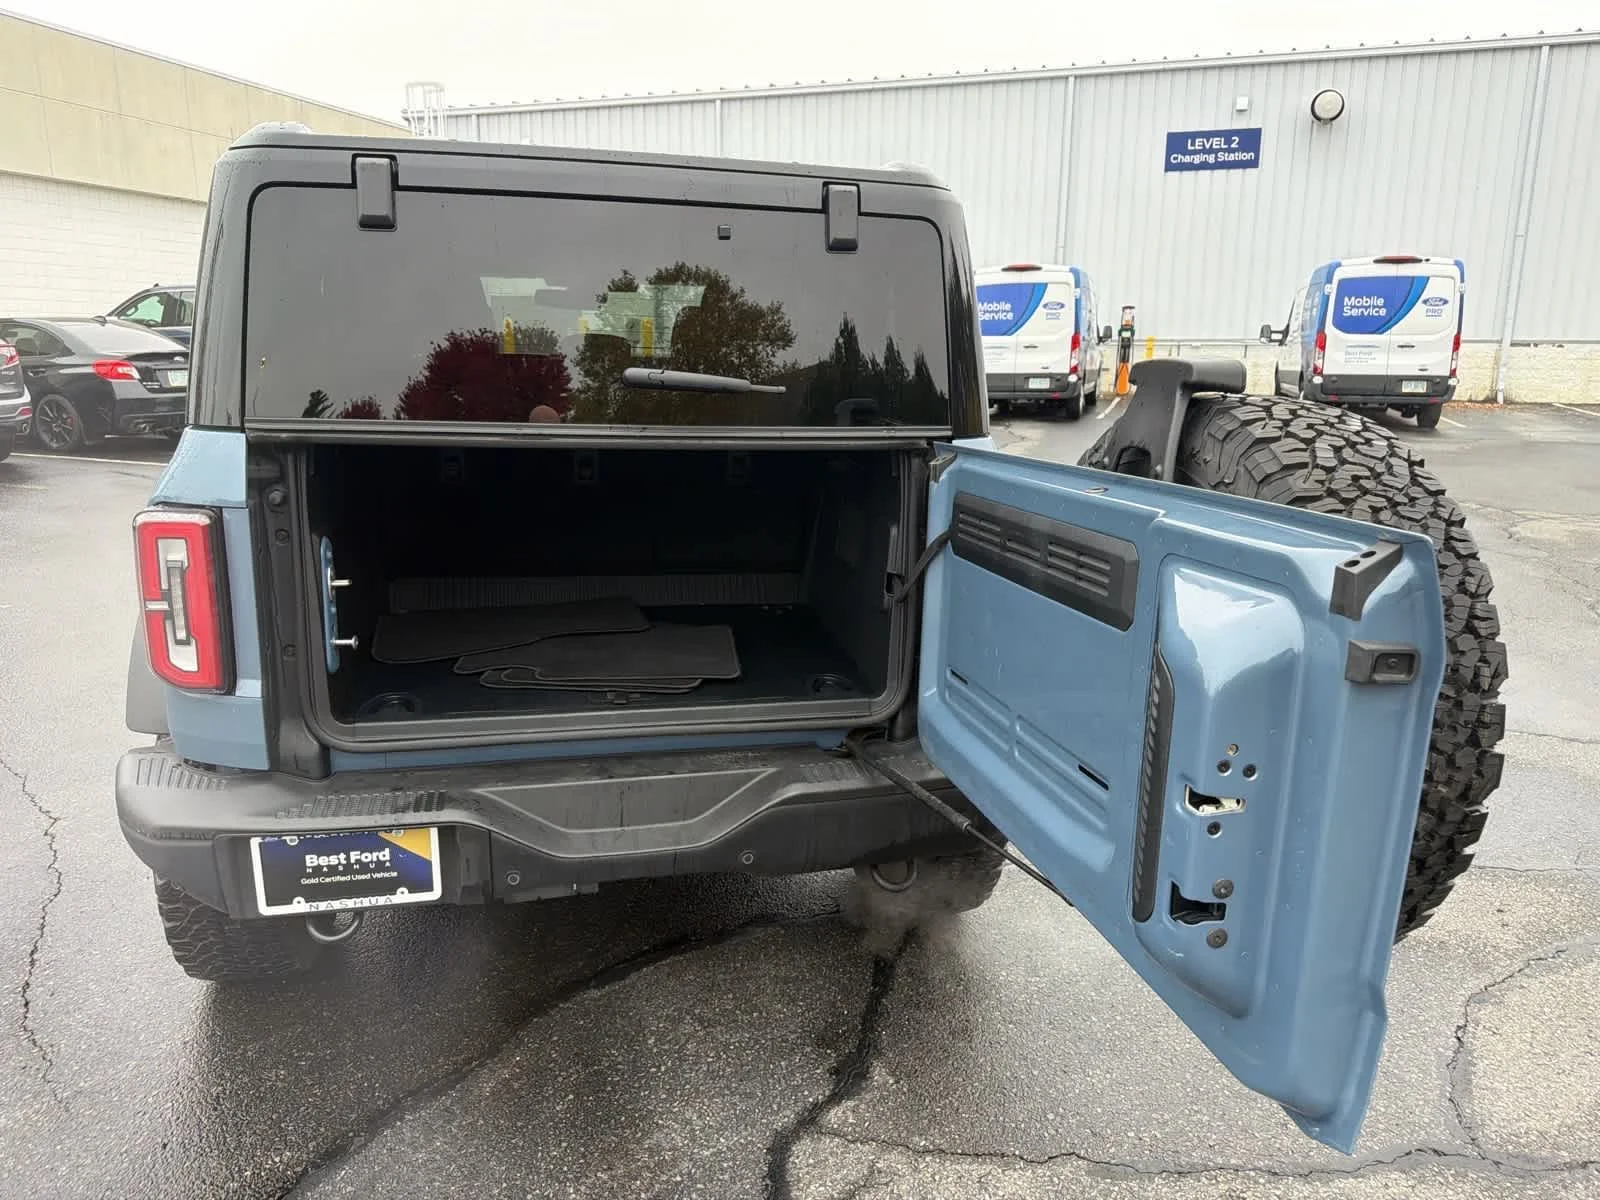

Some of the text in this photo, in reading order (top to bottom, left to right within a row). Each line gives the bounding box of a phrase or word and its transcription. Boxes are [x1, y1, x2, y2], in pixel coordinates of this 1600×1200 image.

[1187, 136, 1240, 150] LEVEL 2
[1170, 151, 1255, 164] Charging Station
[979, 301, 1012, 311] Mobile
[1343, 296, 1385, 306] Mobile
[978, 311, 1014, 321] Service
[1343, 306, 1387, 316] Service
[305, 848, 391, 867] Best Ford
[306, 861, 391, 873] NASHUA
[301, 871, 398, 885] Gold Certified Used Vehicle
[309, 896, 393, 912] NASHUA
